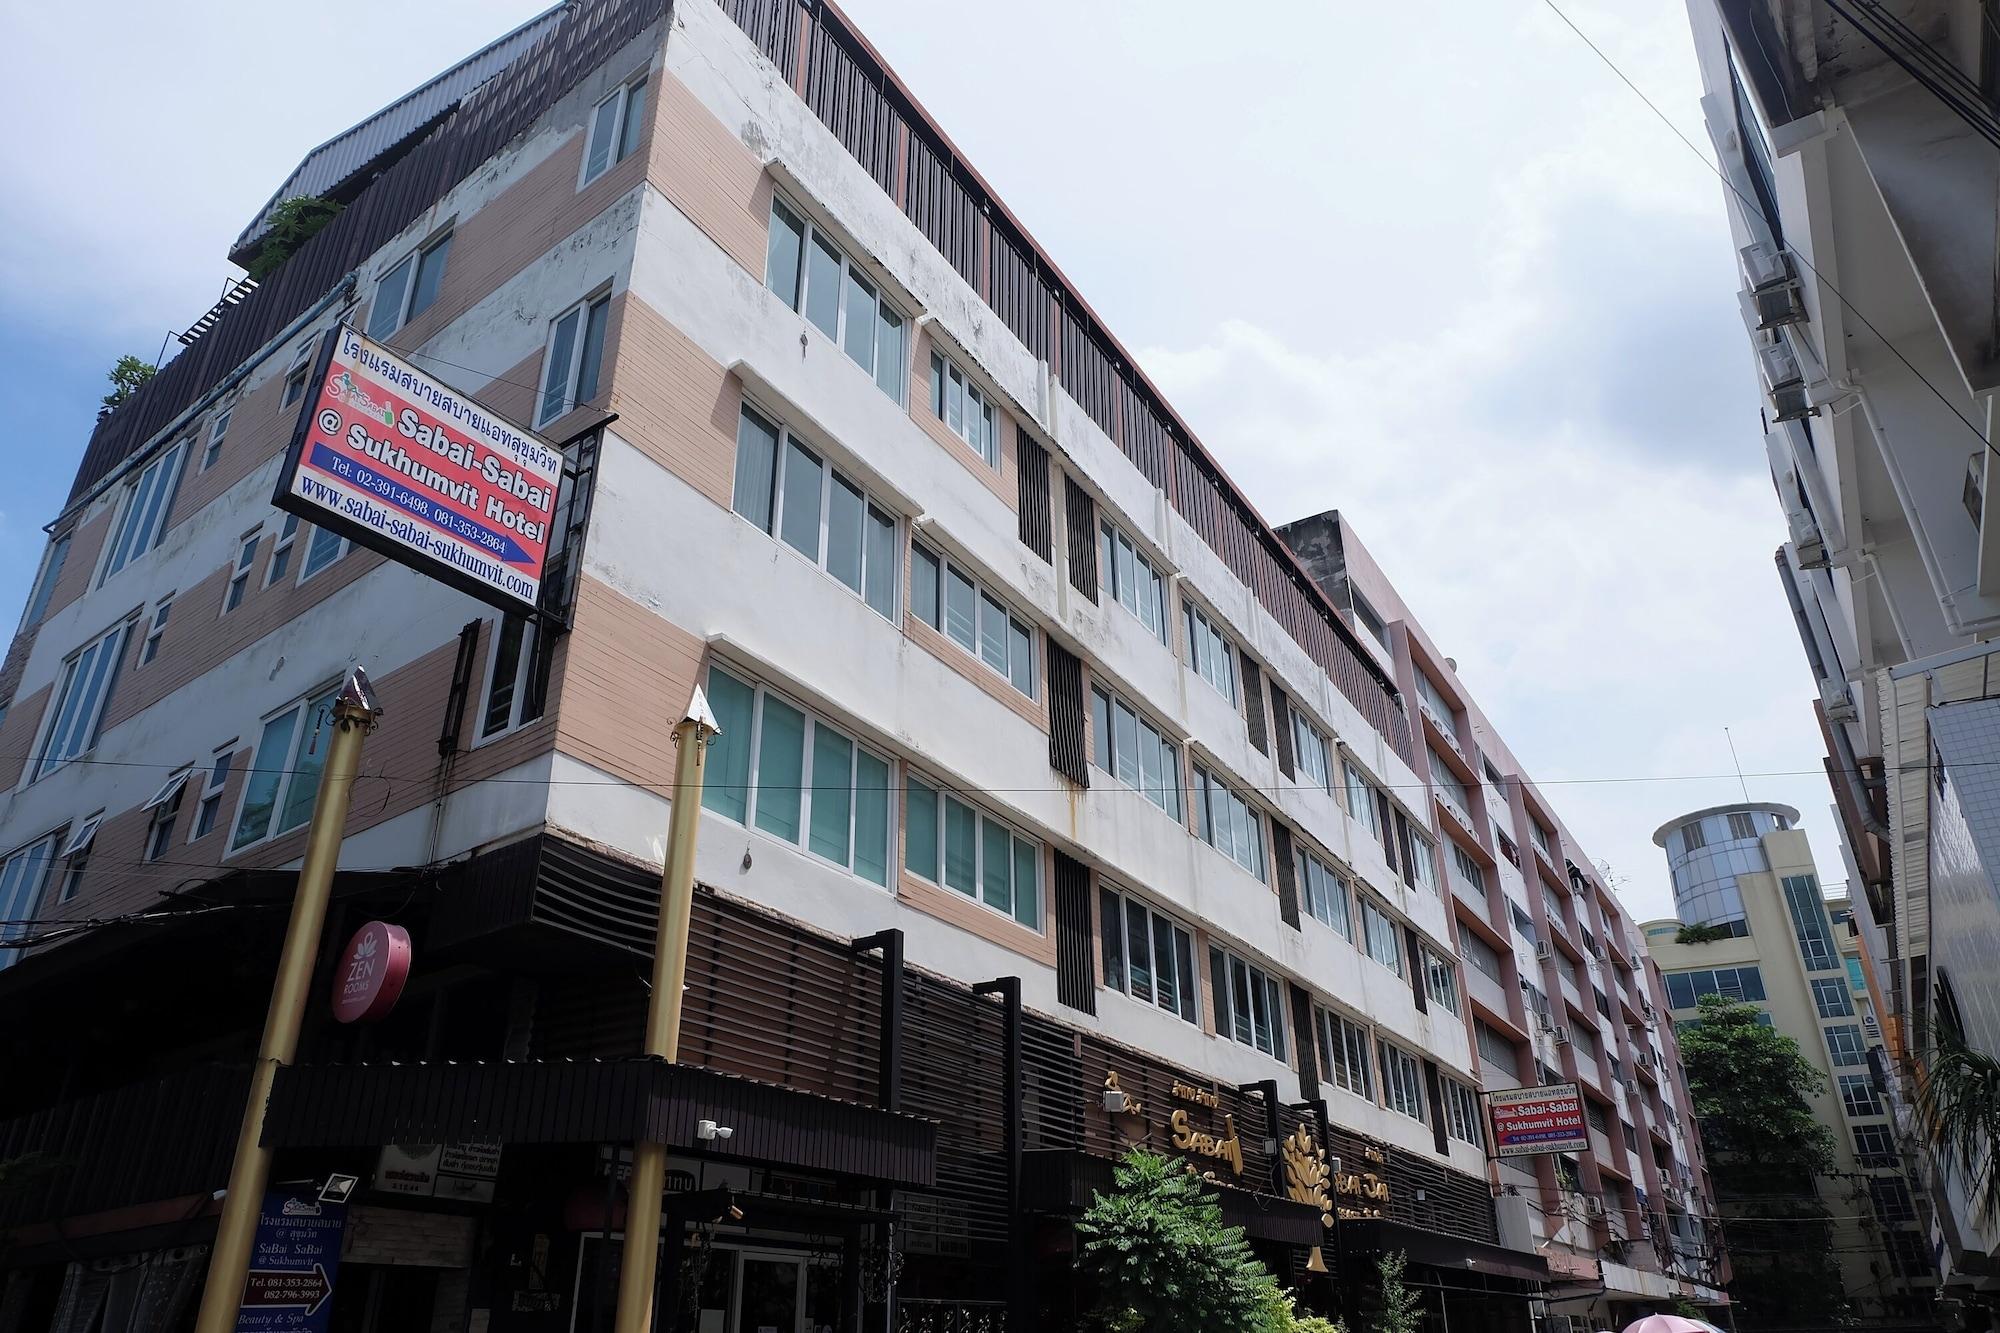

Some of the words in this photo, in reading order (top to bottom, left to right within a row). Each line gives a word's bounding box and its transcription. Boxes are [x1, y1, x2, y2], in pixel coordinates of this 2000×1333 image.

[398, 408, 551, 513] Sabai-Sabai
[318, 408, 343, 436] @
[346, 423, 479, 510] Sukhumvit
[484, 491, 544, 544] Hotel
[302, 475, 534, 600] www.sabai-sabai-sukhumvit.com
[434, 508, 506, 554] 081-353-2864
[347, 959, 375, 982] ZEN
[1517, 1100, 1578, 1117] Sabai-Sabai
[1506, 1118, 1554, 1132] Sukhumvit
[1556, 1115, 1582, 1127] Hotel
[294, 1243, 323, 1255] SaBai
[269, 1255, 314, 1266] Sukhumvit
[268, 1278, 323, 1287] 081-353-2864
[264, 1290, 320, 1300] 082-796-3993
[238, 1313, 271, 1327] Beauty
[275, 1313, 283, 1323] &
[286, 1313, 304, 1326] Spa
